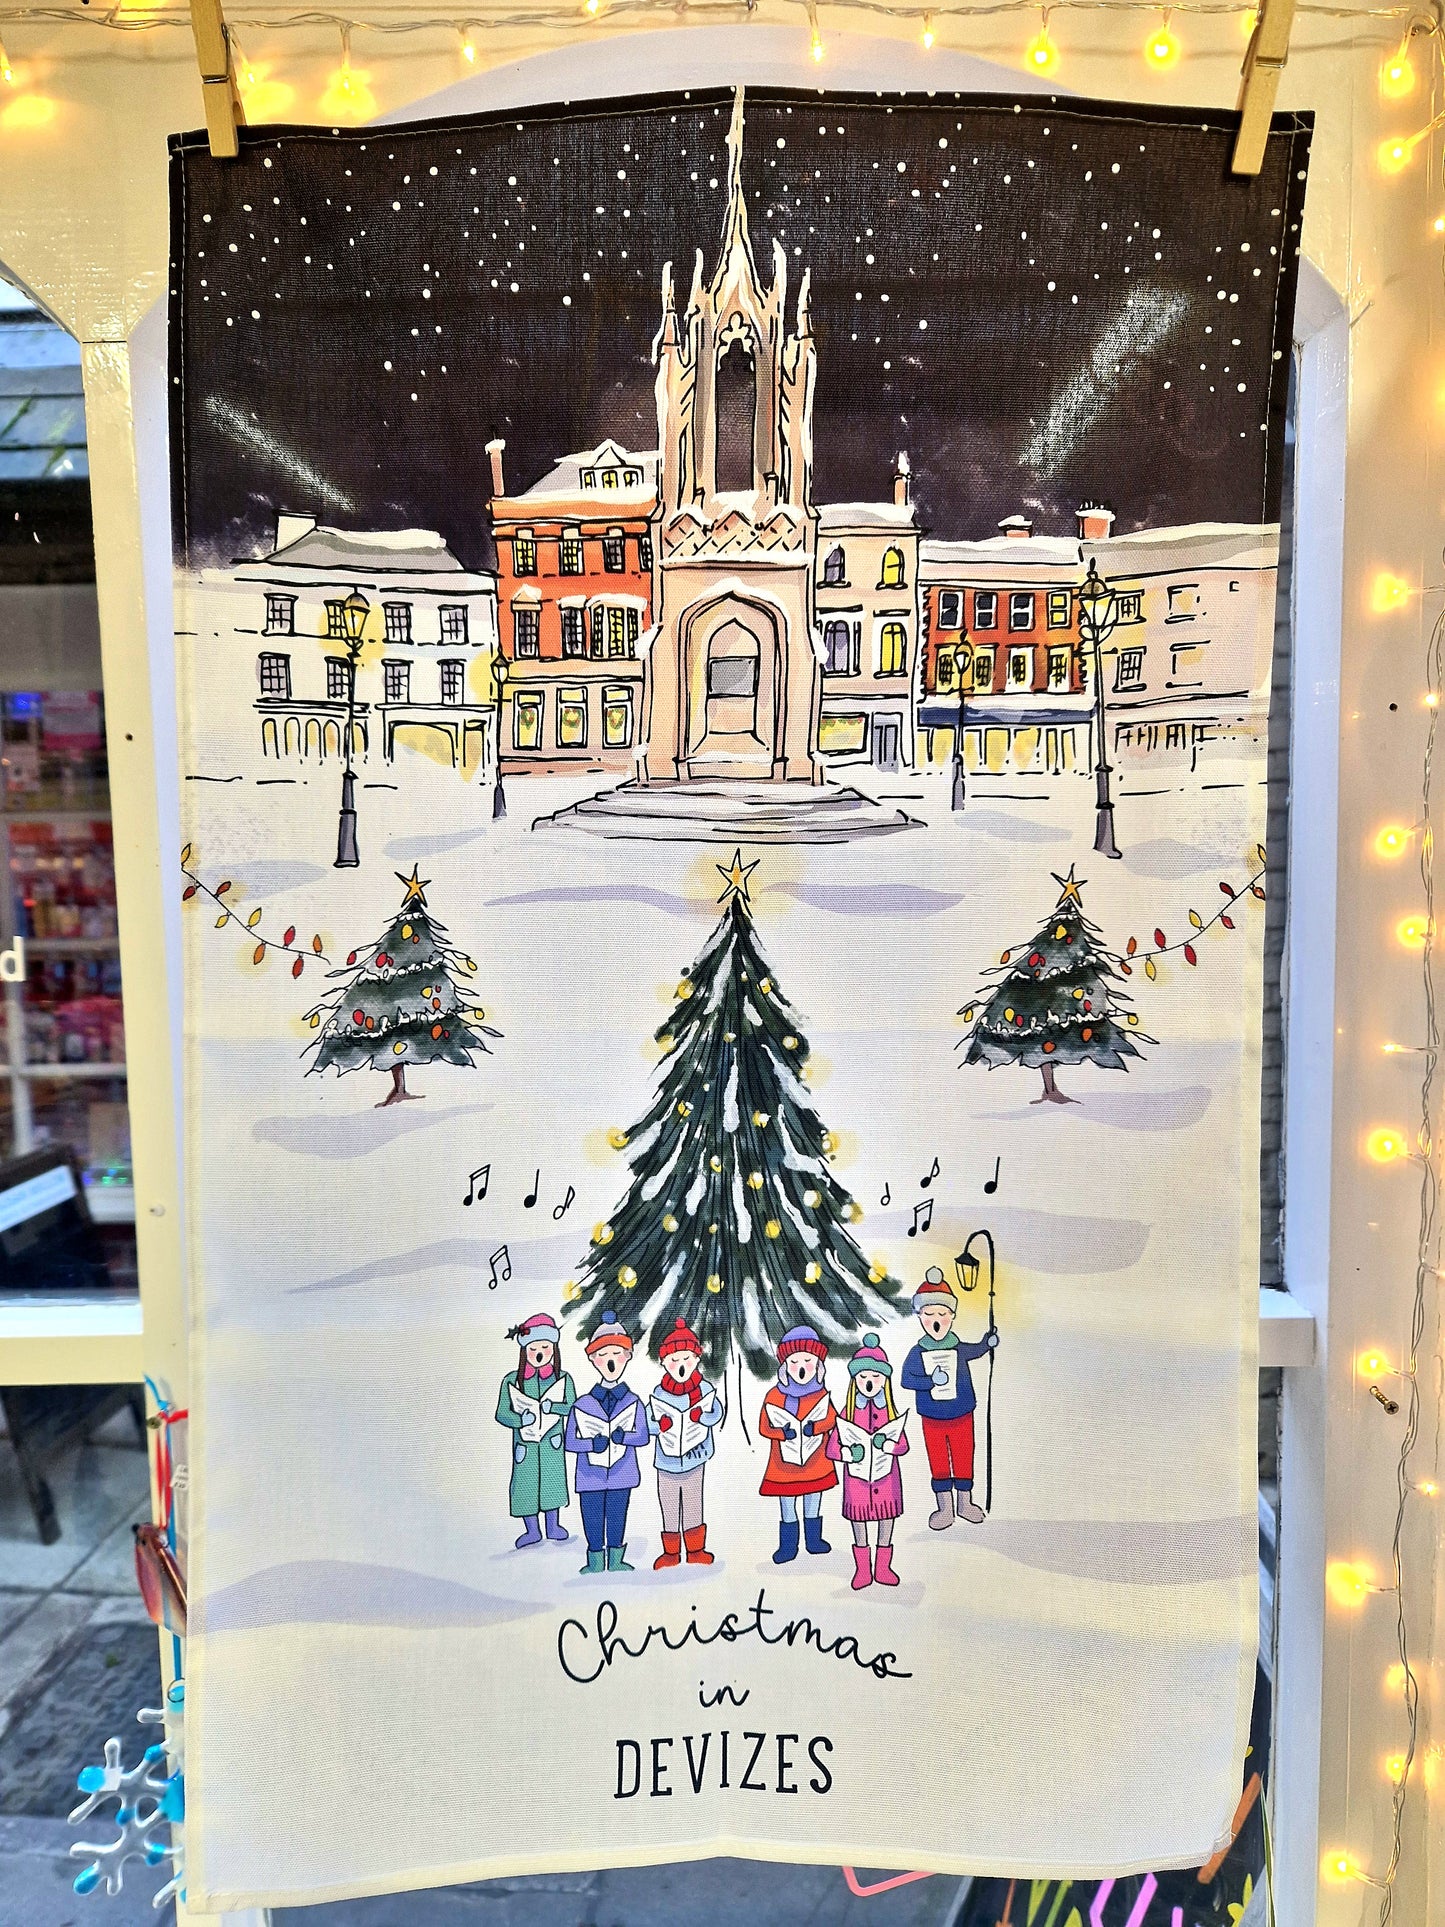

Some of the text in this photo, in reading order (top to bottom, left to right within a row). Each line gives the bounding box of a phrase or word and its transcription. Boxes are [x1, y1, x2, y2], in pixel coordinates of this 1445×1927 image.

[557, 1588, 913, 1684] Christmas
[699, 1680, 750, 1708] in
[613, 1730, 834, 1799] DEVIZES
